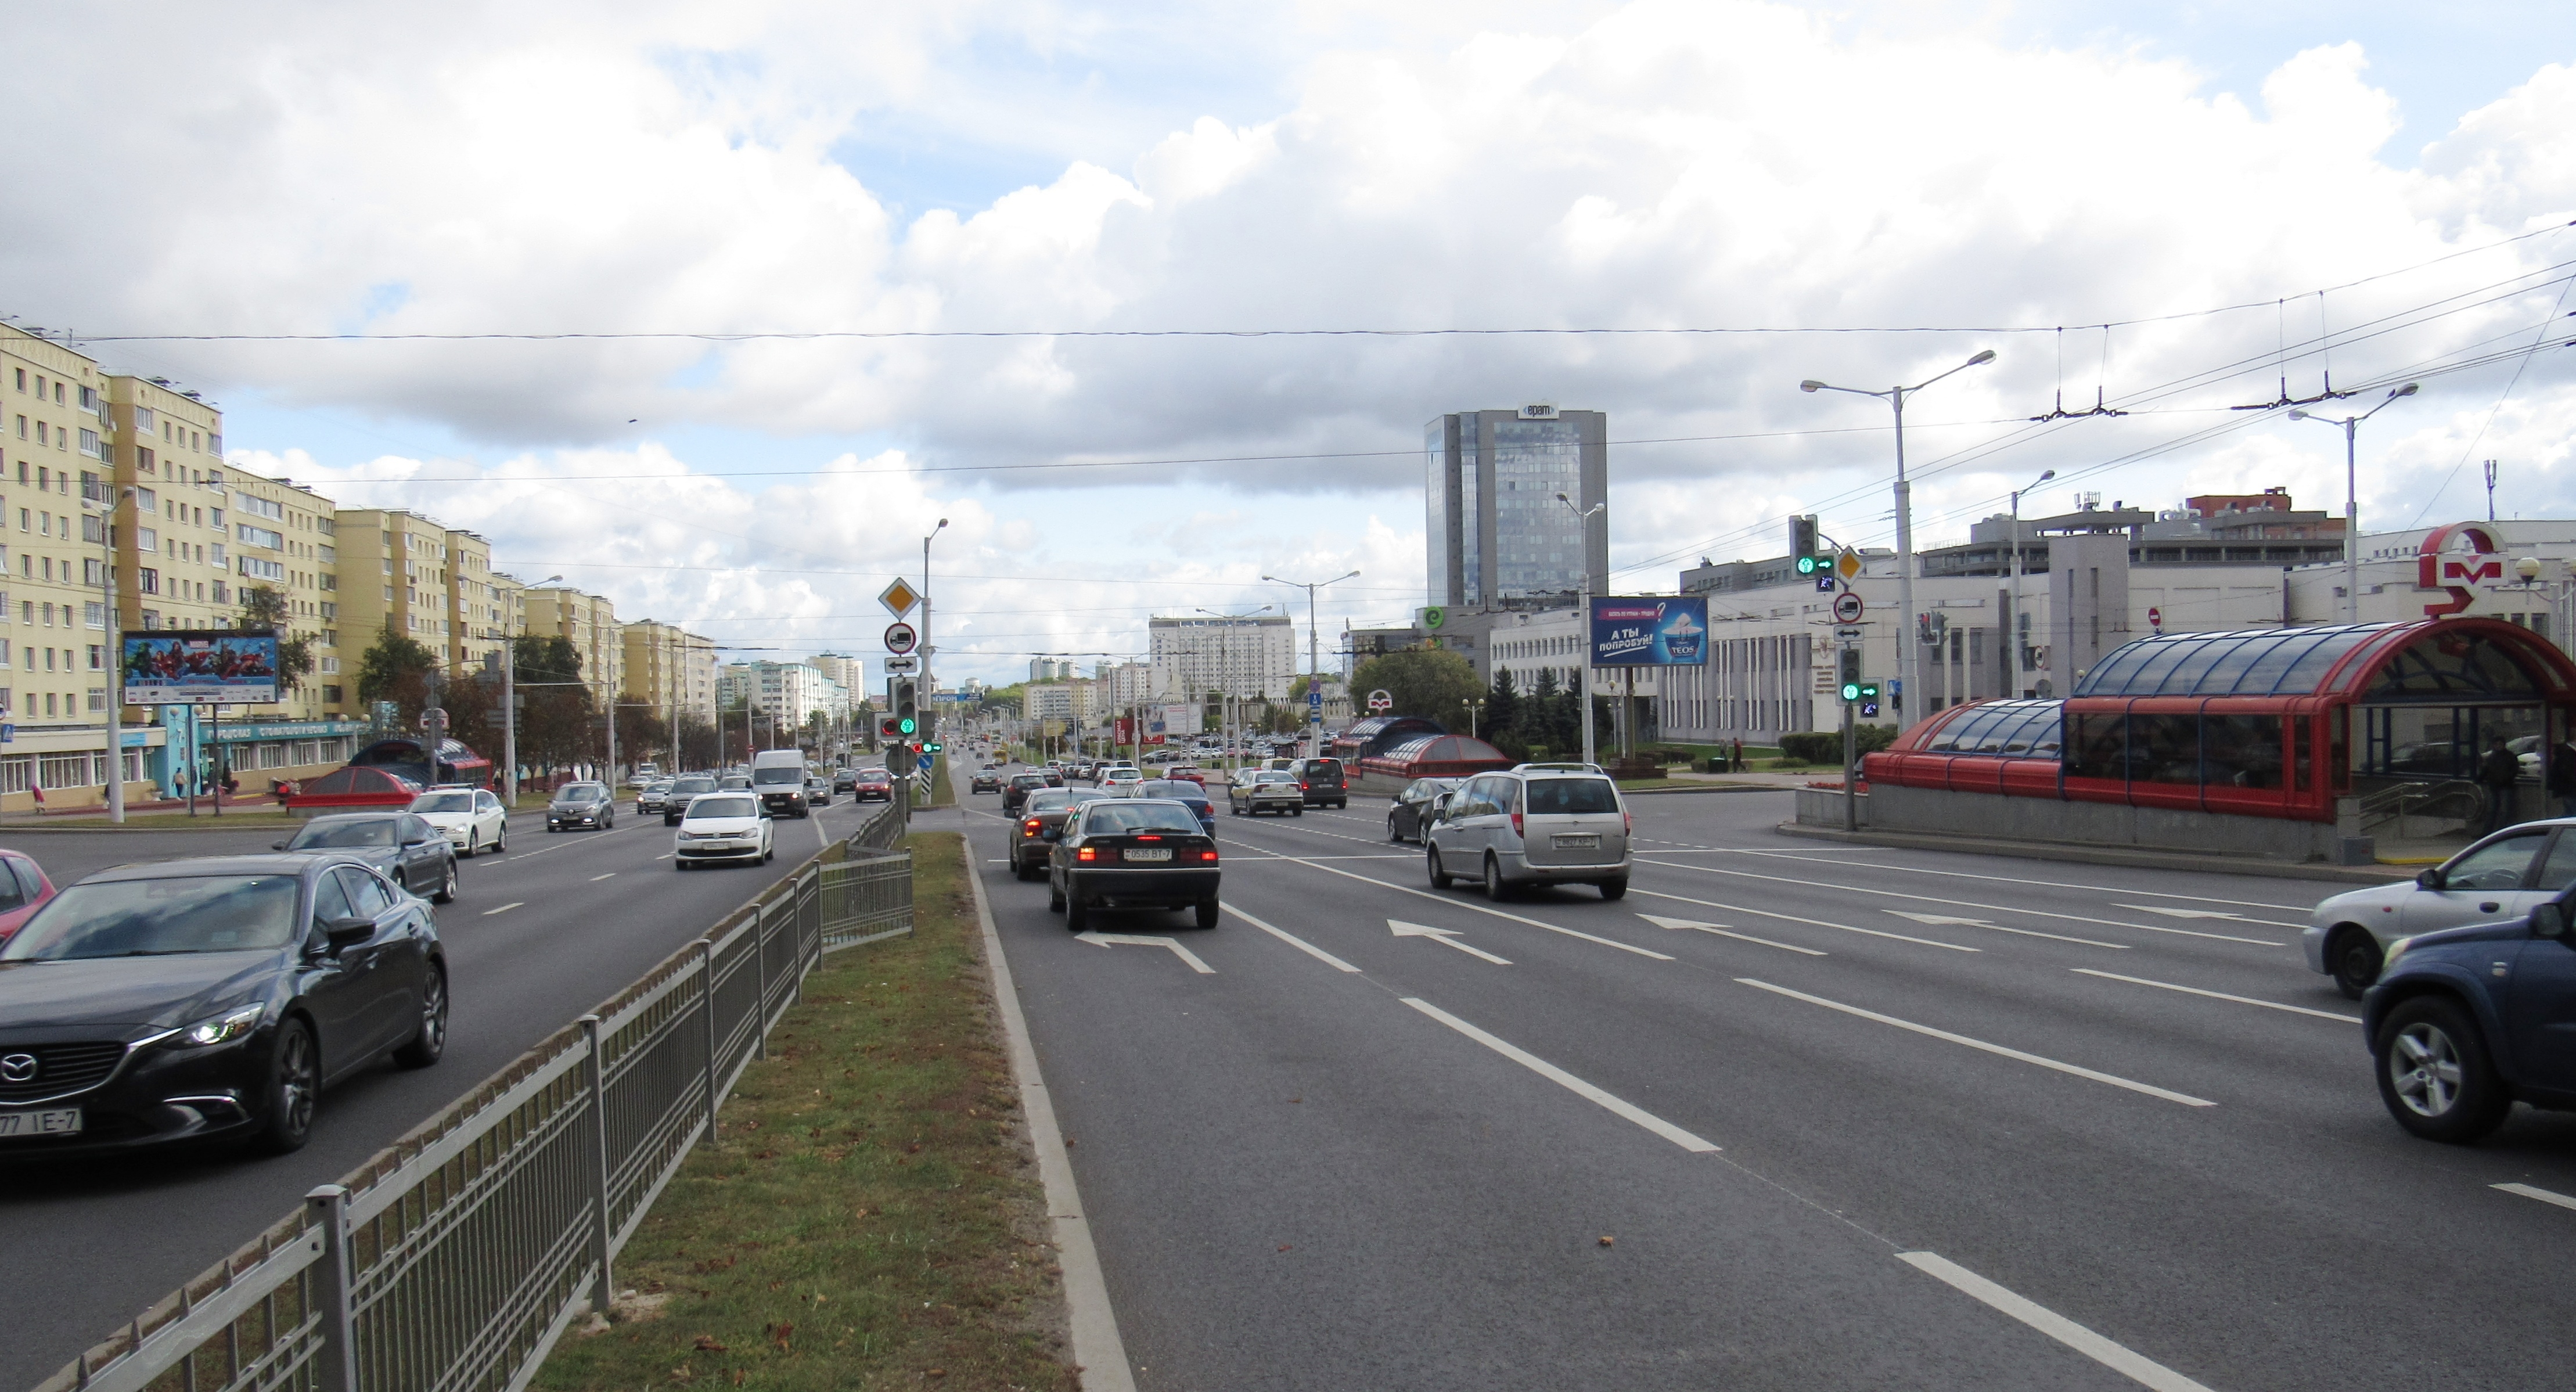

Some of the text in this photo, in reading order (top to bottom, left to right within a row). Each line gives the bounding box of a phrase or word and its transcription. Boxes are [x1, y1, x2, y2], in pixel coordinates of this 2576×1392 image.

[1528, 405, 1549, 417] epam
[1611, 627, 1639, 641] А ТЫ
[1599, 634, 1653, 652] ПОПРОБУЙ!
[1671, 646, 1694, 654] TEOS
[1132, 850, 1170, 858] 0535 BT-7
[33, 1110, 76, 1132] IE-7
